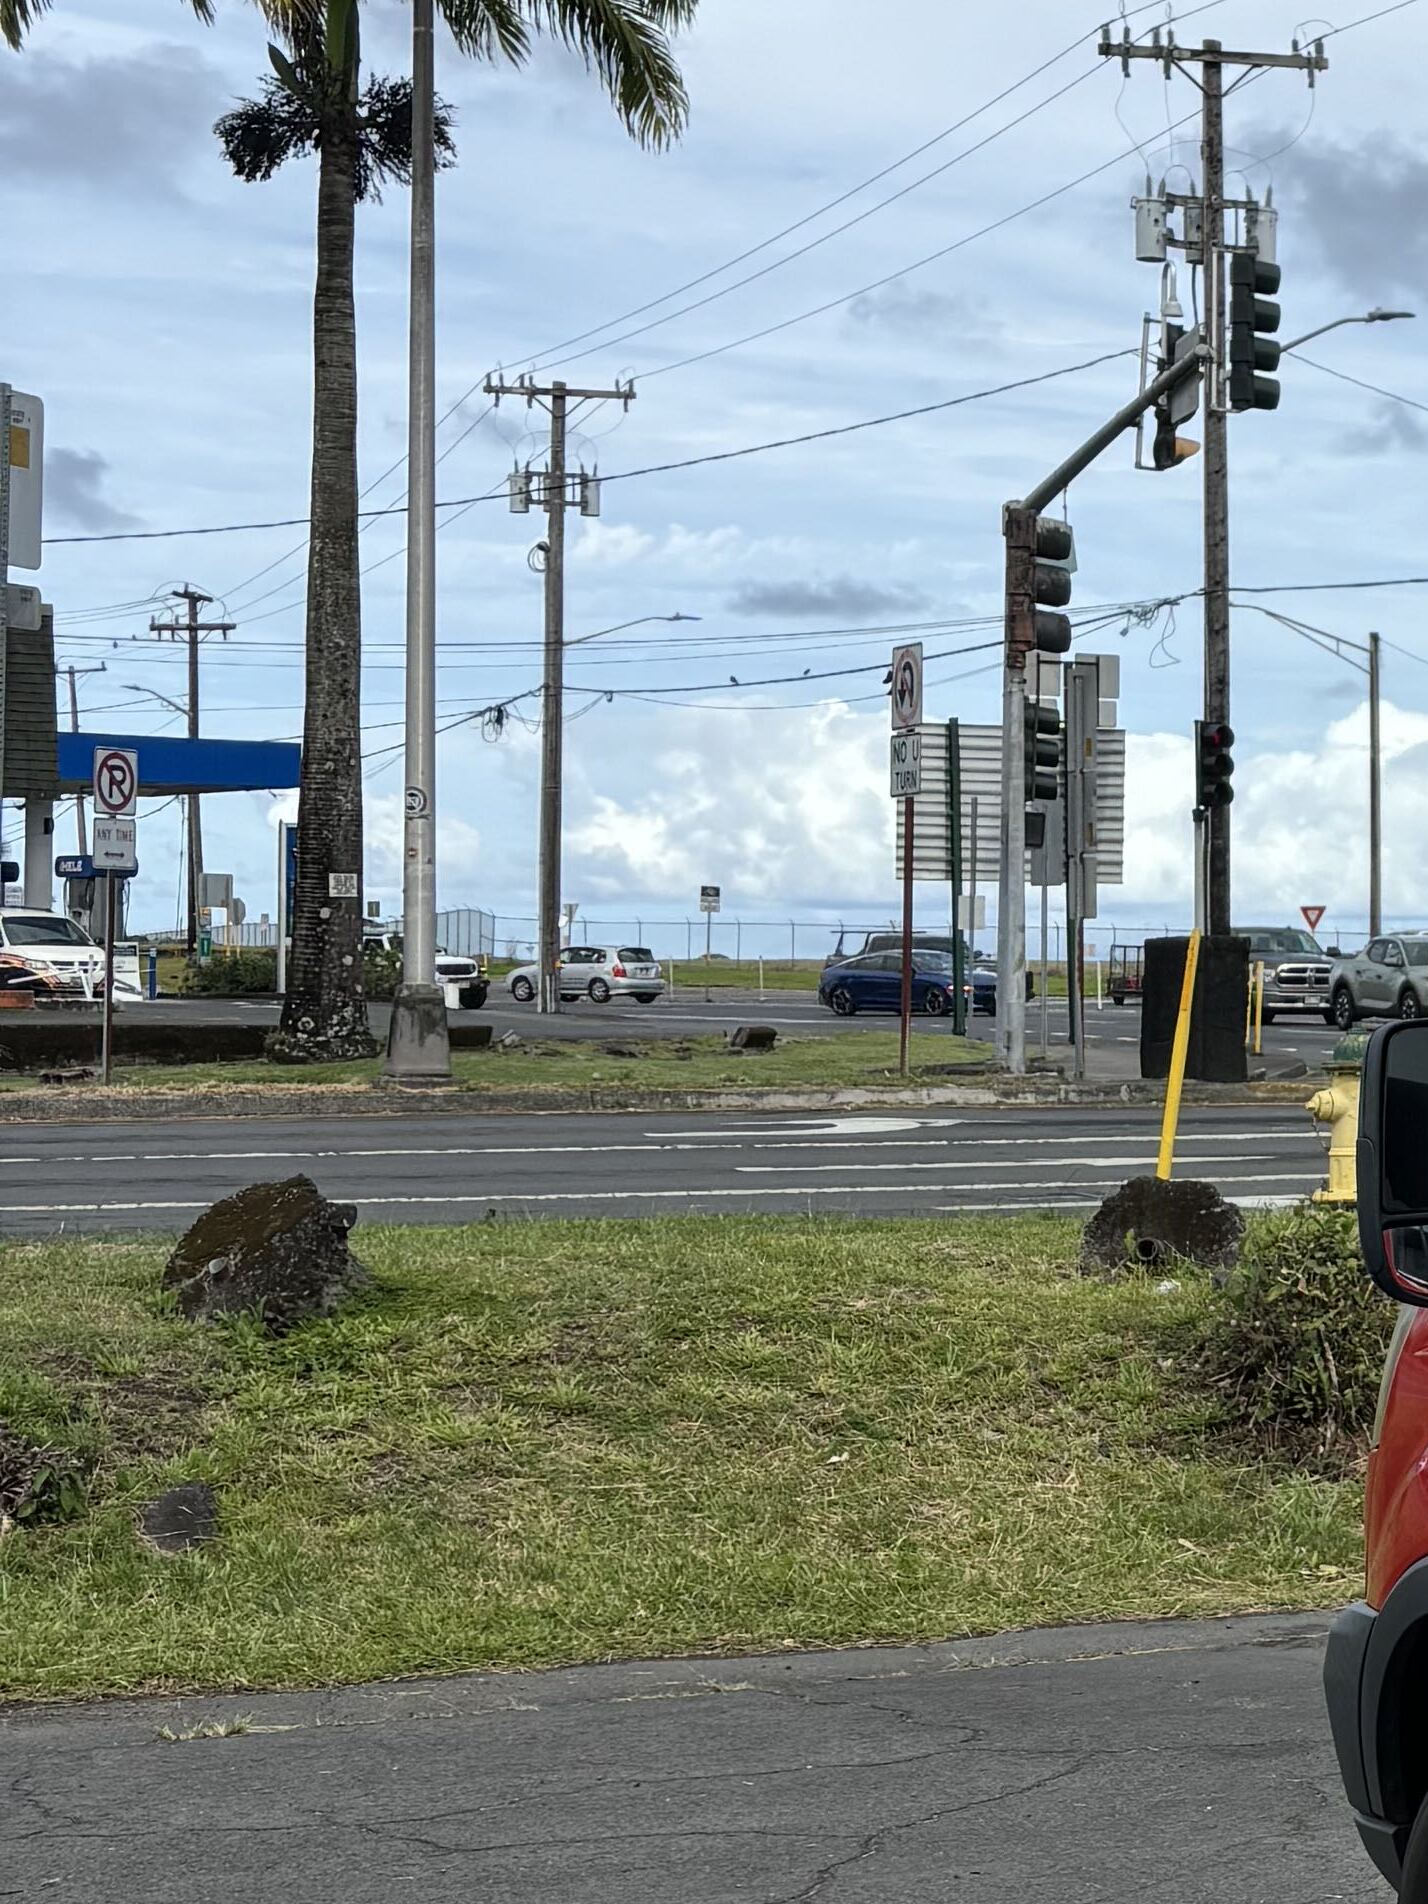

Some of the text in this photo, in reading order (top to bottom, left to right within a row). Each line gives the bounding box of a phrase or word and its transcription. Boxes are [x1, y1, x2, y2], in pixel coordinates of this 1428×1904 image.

[894, 738, 919, 764] NO U
[894, 769, 917, 792] TURN
[97, 828, 133, 842] ANY TIME
